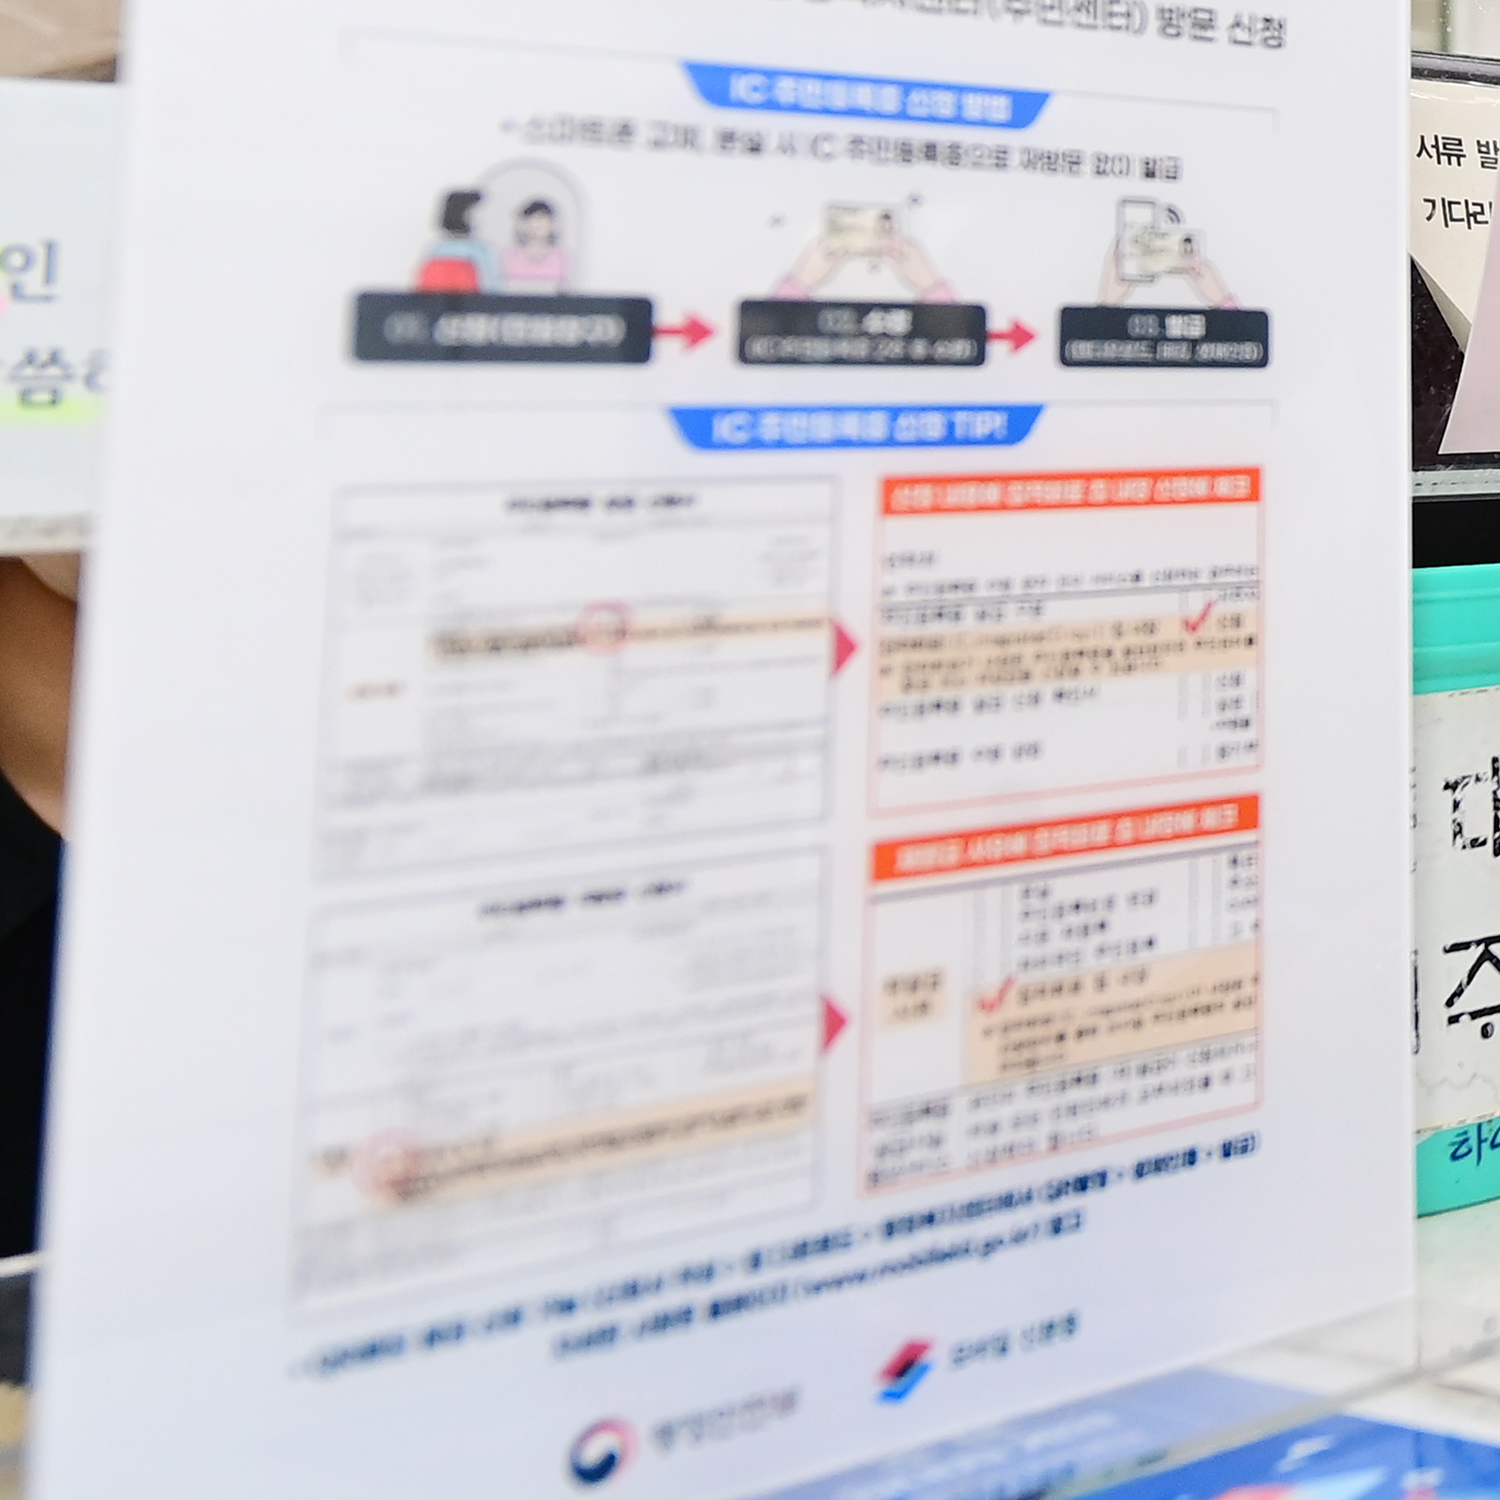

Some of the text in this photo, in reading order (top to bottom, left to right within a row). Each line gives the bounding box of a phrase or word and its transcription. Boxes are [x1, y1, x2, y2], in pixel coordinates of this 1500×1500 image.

[1155, 1, 1218, 42] 방문
[1227, 9, 1288, 51] 신청
[1415, 133, 1466, 167] 서류
[1423, 197, 1493, 229] 기다리
